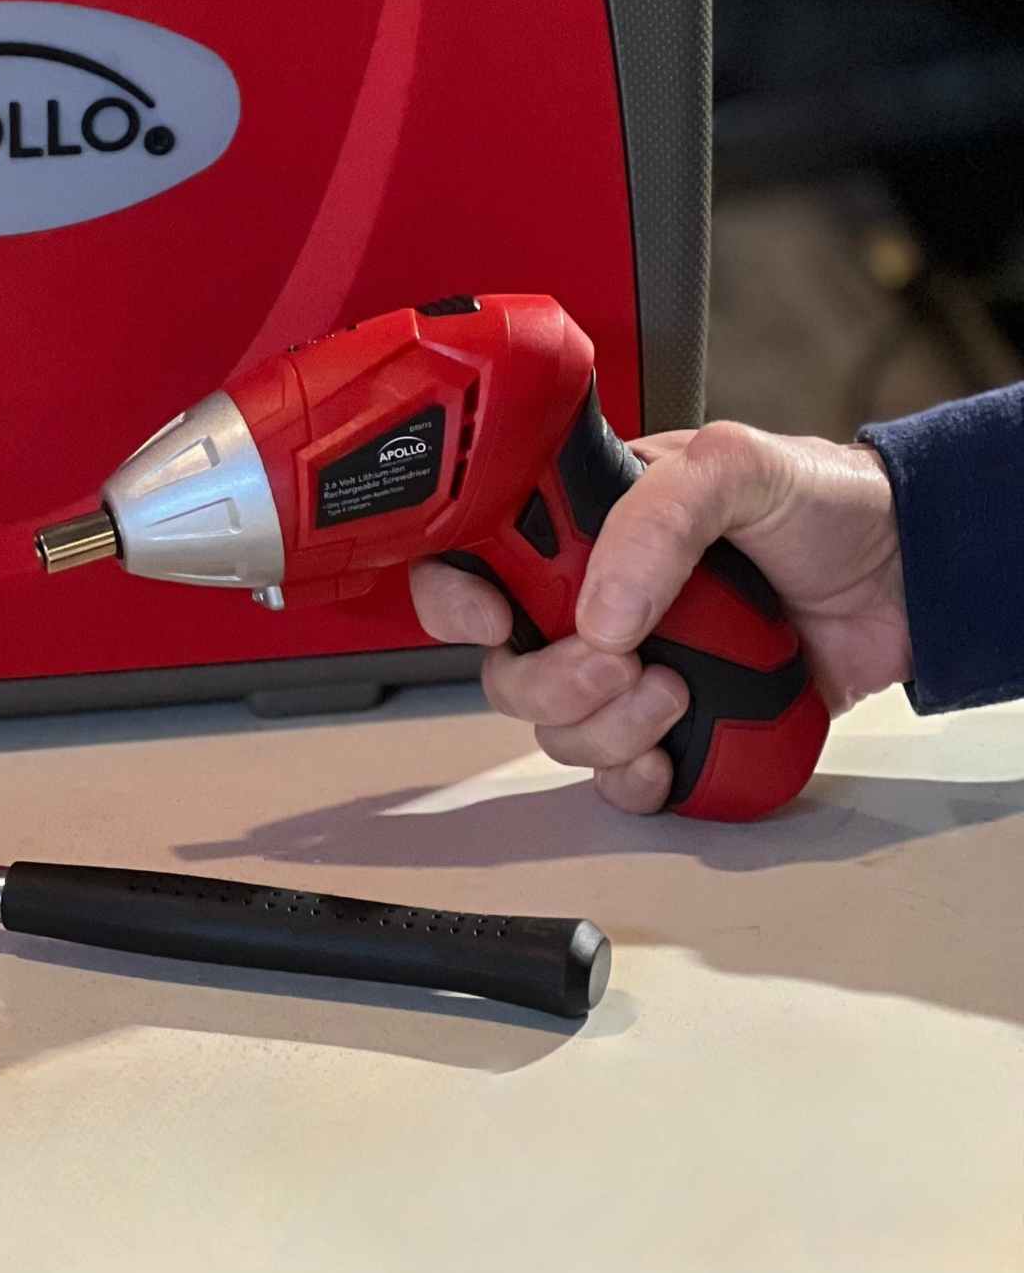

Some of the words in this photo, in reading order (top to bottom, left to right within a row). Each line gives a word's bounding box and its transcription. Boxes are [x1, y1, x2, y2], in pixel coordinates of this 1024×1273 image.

[379, 442, 427, 463] APOLLO
[323, 479, 380, 499] Rechargeable
[382, 467, 432, 486] Screwdriver
[339, 476, 356, 486] Volt
